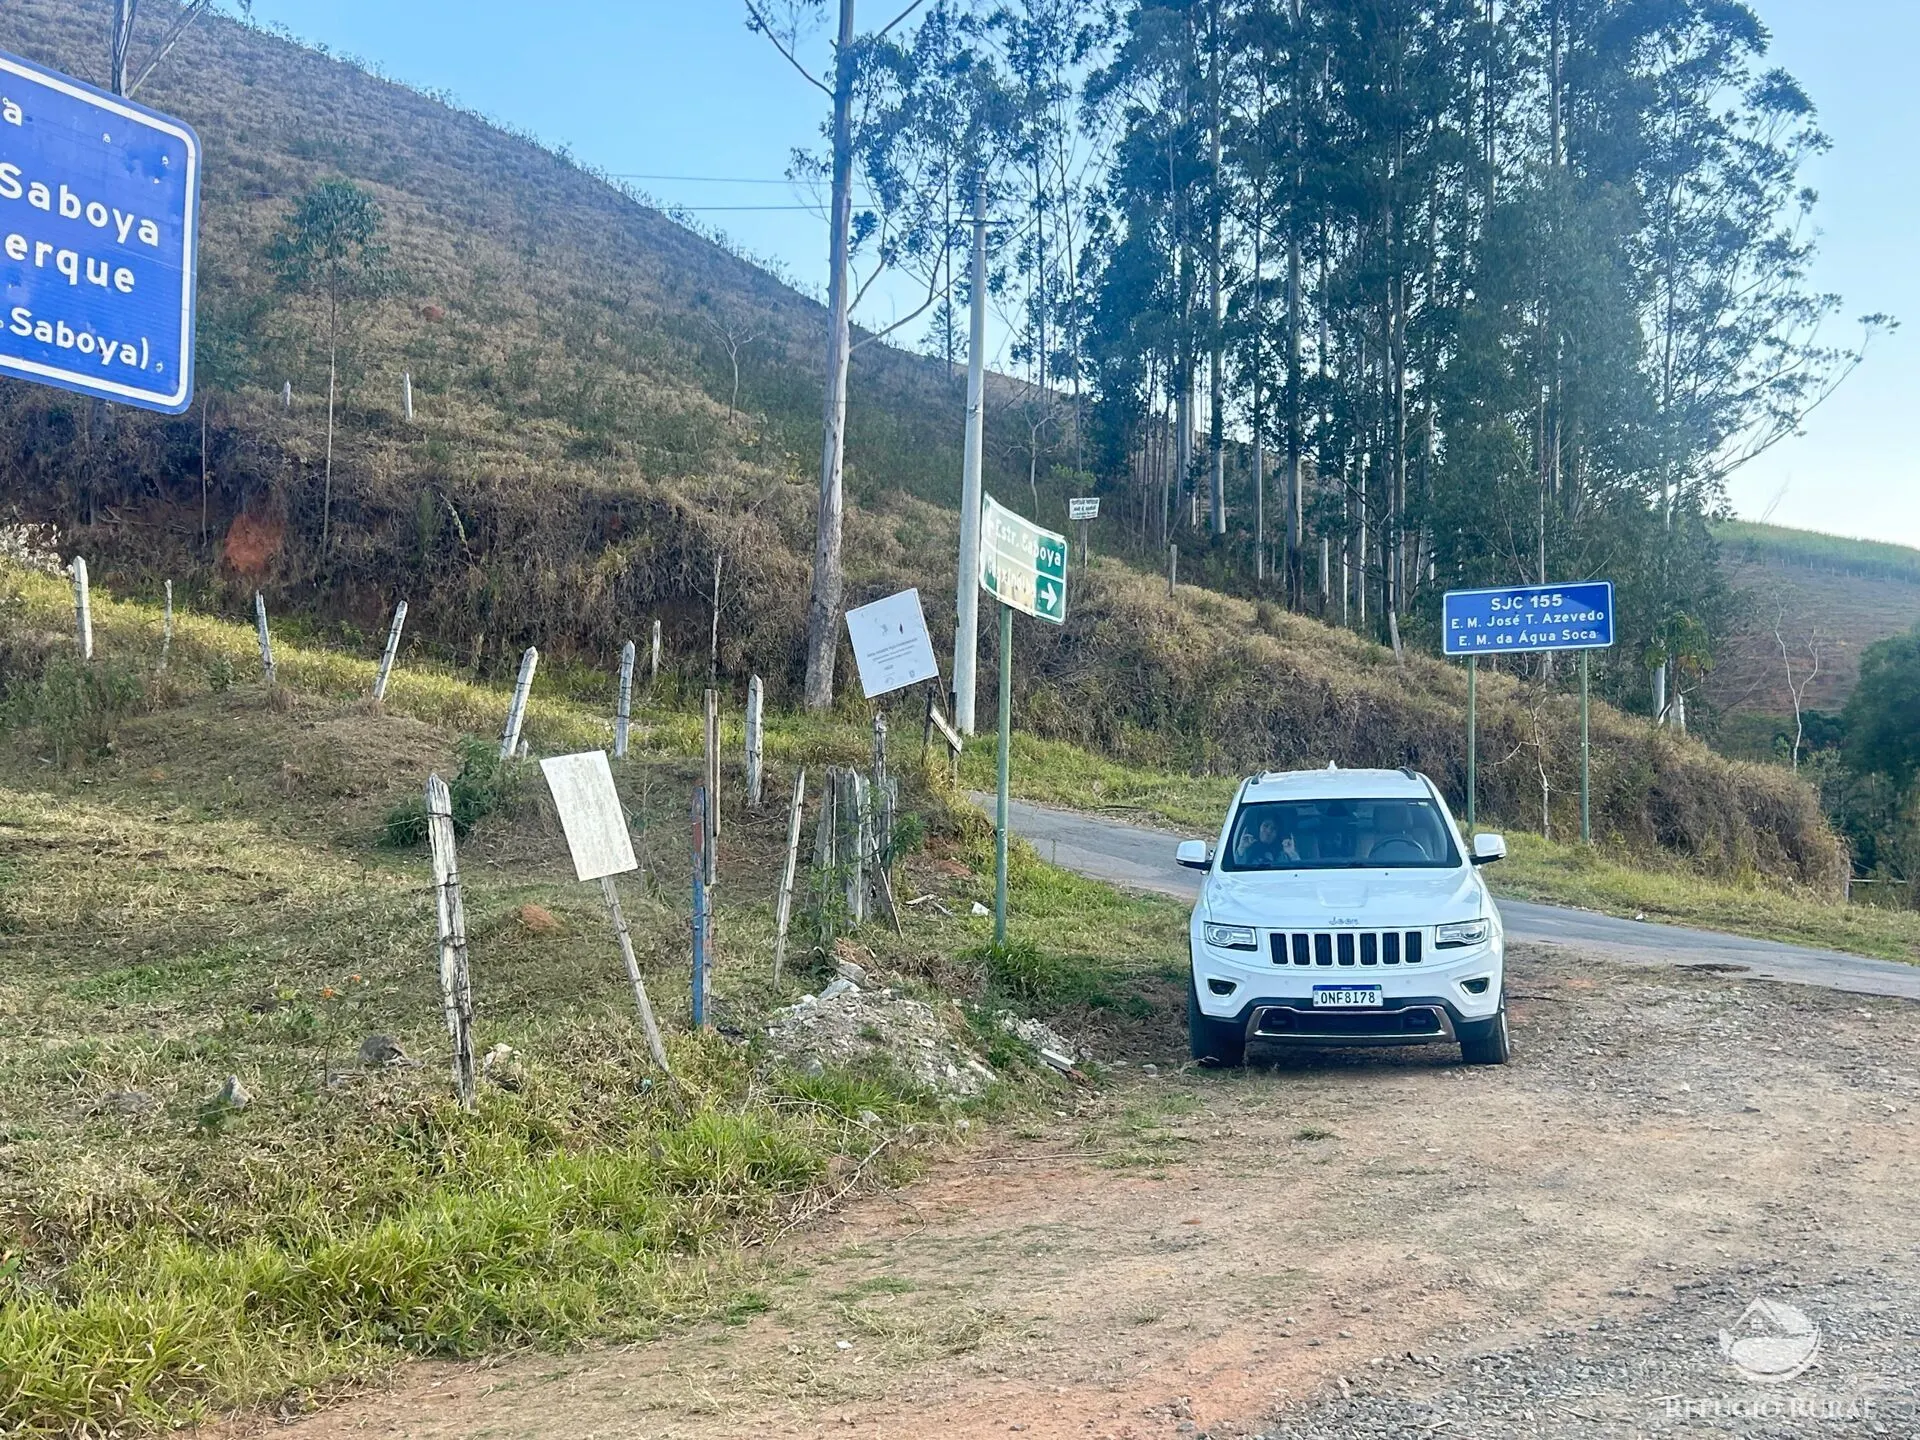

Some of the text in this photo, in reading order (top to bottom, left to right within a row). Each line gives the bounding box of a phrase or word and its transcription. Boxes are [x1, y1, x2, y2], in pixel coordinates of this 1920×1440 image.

[0, 162, 159, 247] Saboya
[1491, 593, 1563, 611] SJC 155
[1451, 610, 1605, 629] E. M. José T. Azevedo
[1459, 629, 1596, 646] E. M. da Água Soca
